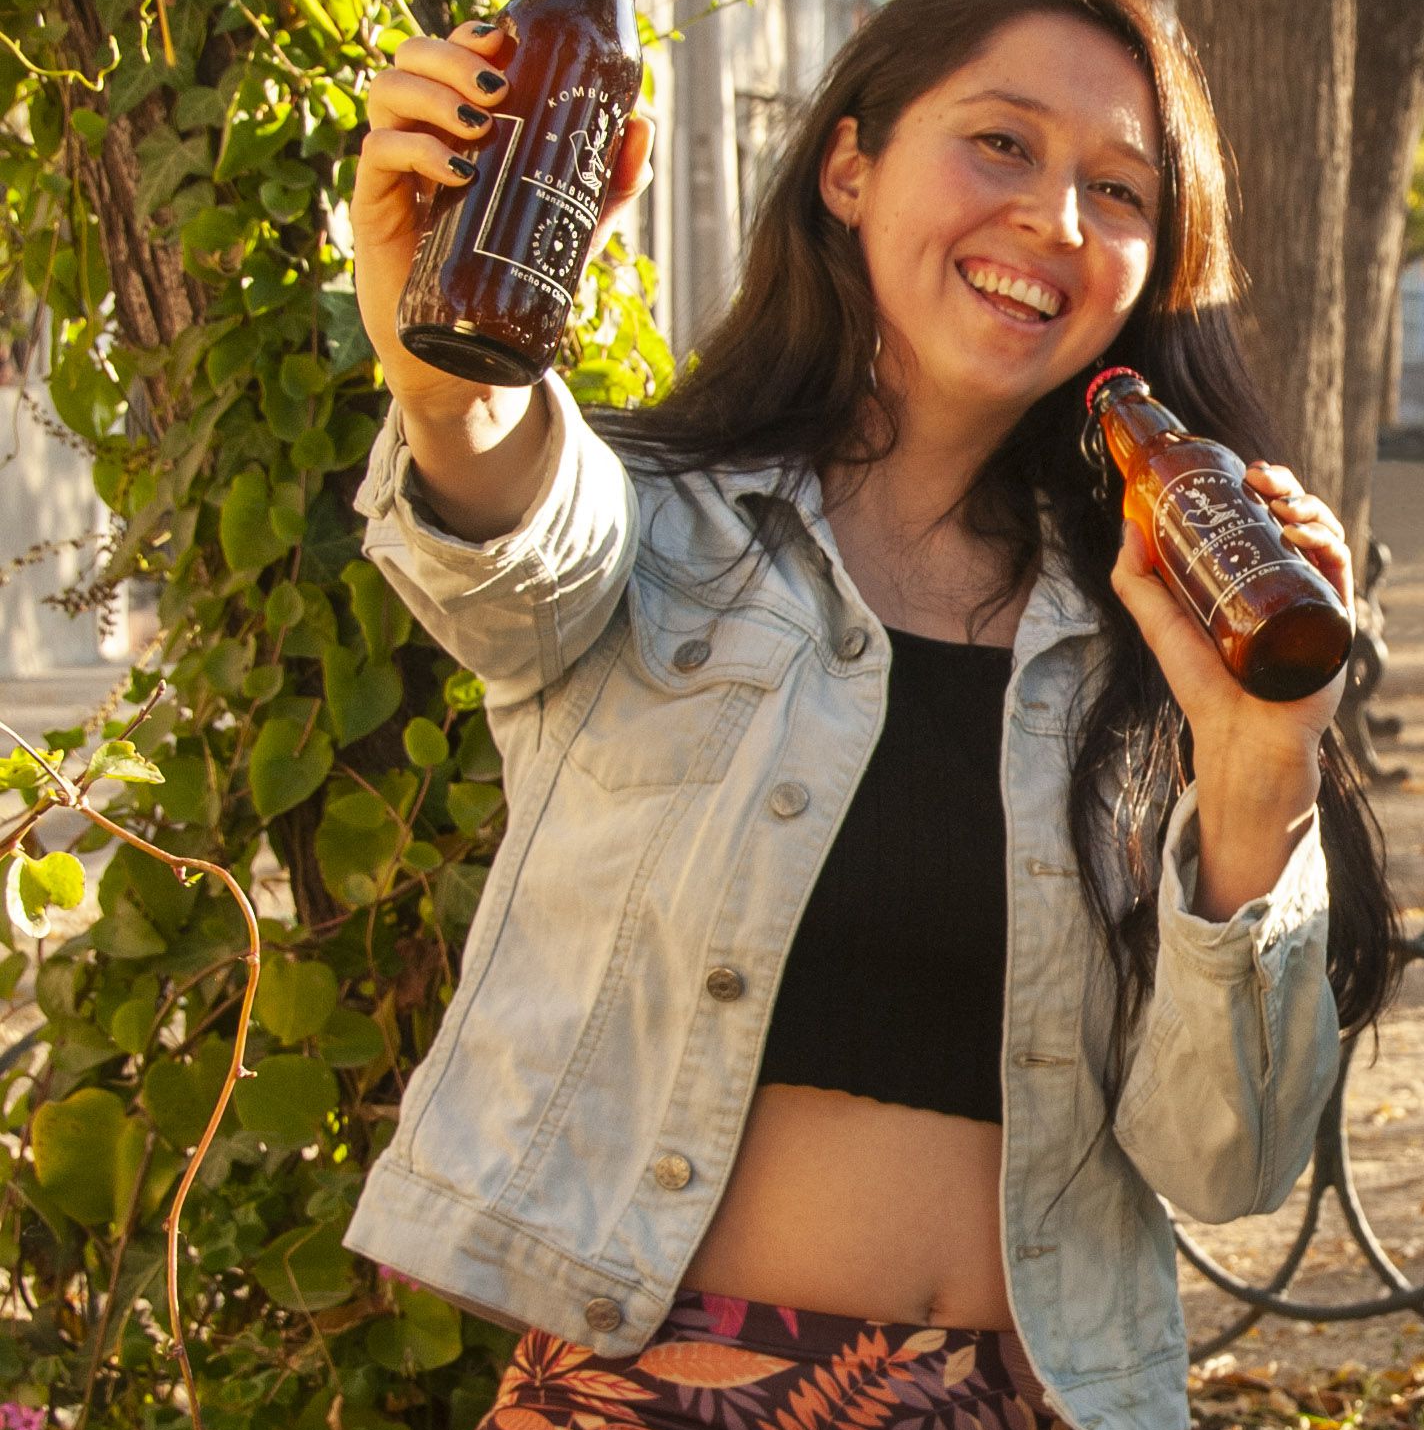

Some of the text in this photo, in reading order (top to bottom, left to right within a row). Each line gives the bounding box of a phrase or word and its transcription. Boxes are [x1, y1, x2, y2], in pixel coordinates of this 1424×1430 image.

[547, 86, 608, 108] KOMBU
[545, 131, 558, 142] 20
[534, 170, 599, 217] KOMBUCHA
[535, 189, 575, 214] Manzana
[510, 266, 540, 287] Hecho
[541, 282, 551, 294] en
[1160, 476, 1240, 538] KOMBU MAPU
[1193, 517, 1255, 555] OMBUCHA
